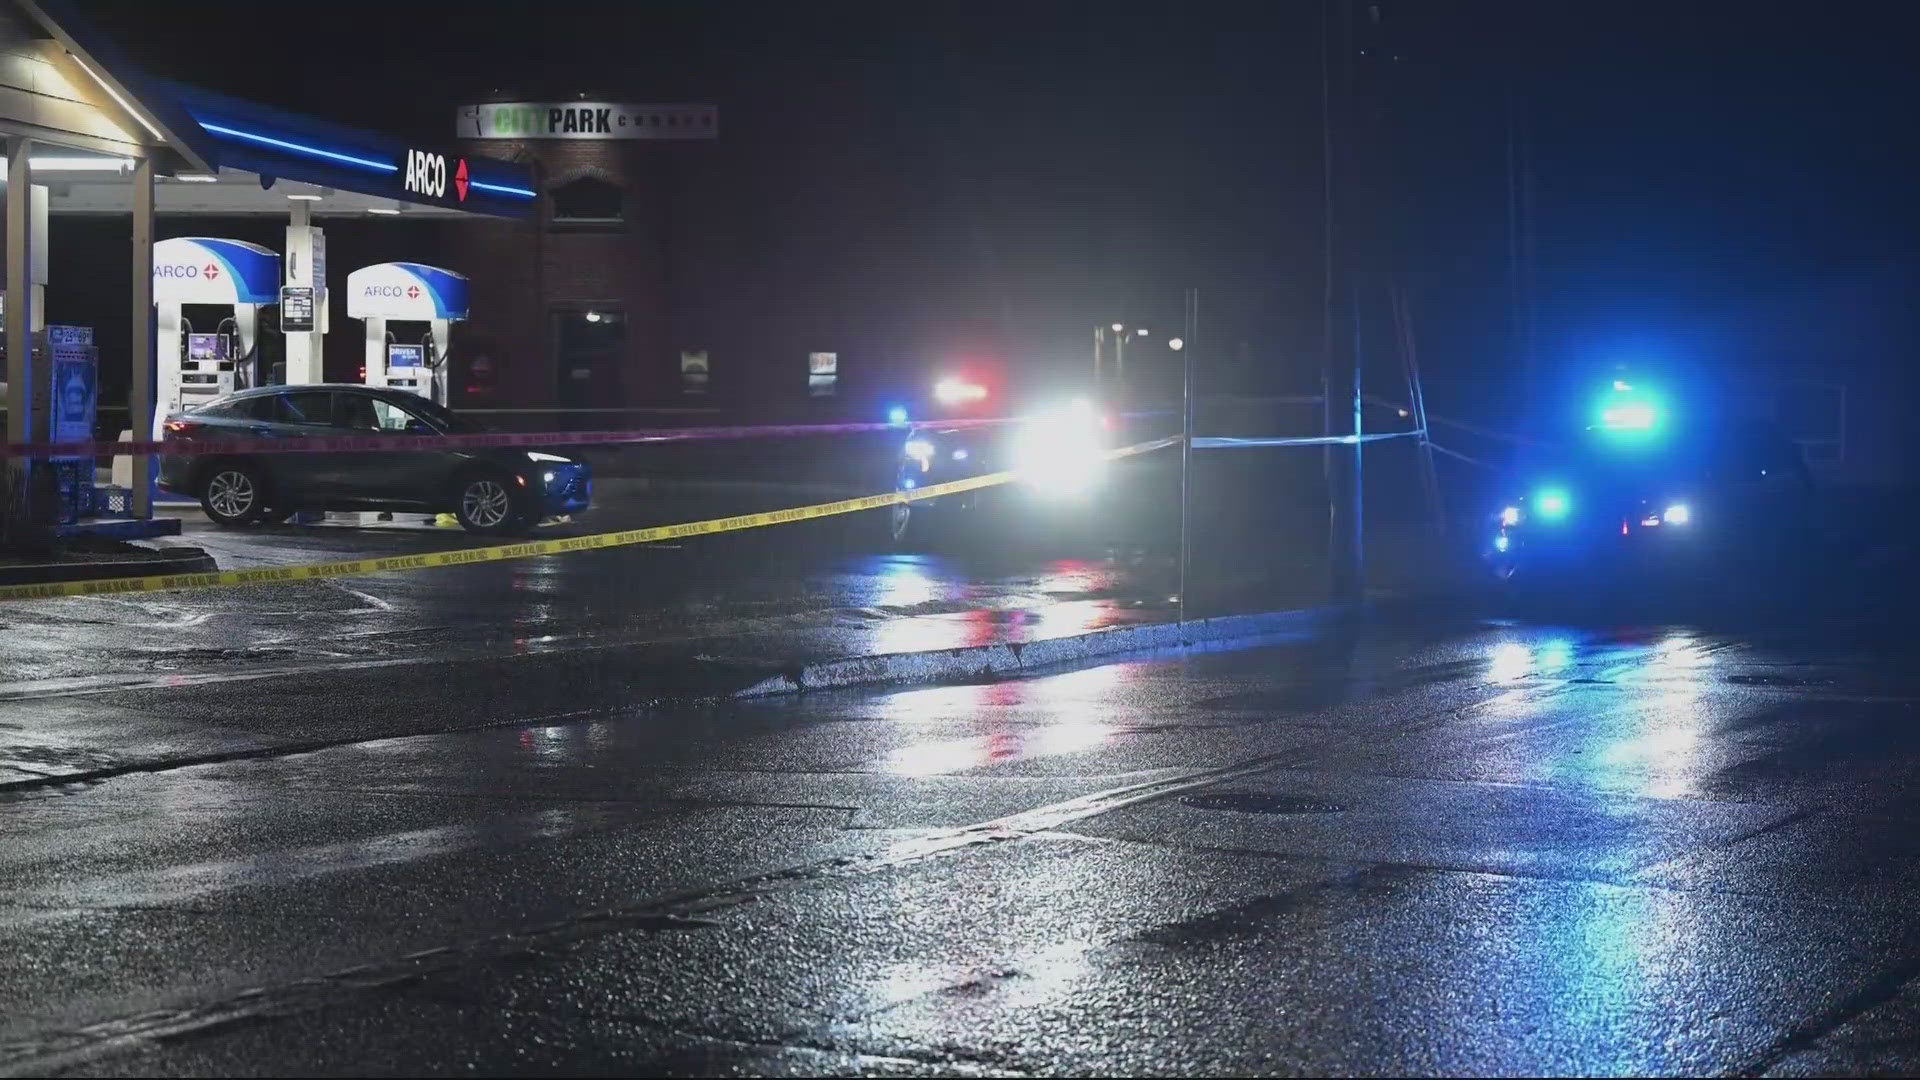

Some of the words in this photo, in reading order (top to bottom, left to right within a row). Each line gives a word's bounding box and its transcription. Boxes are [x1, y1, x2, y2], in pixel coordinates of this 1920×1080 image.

[405, 148, 446, 198] ARCO
[153, 265, 198, 278] ARCO
[364, 286, 402, 298] ARCO
